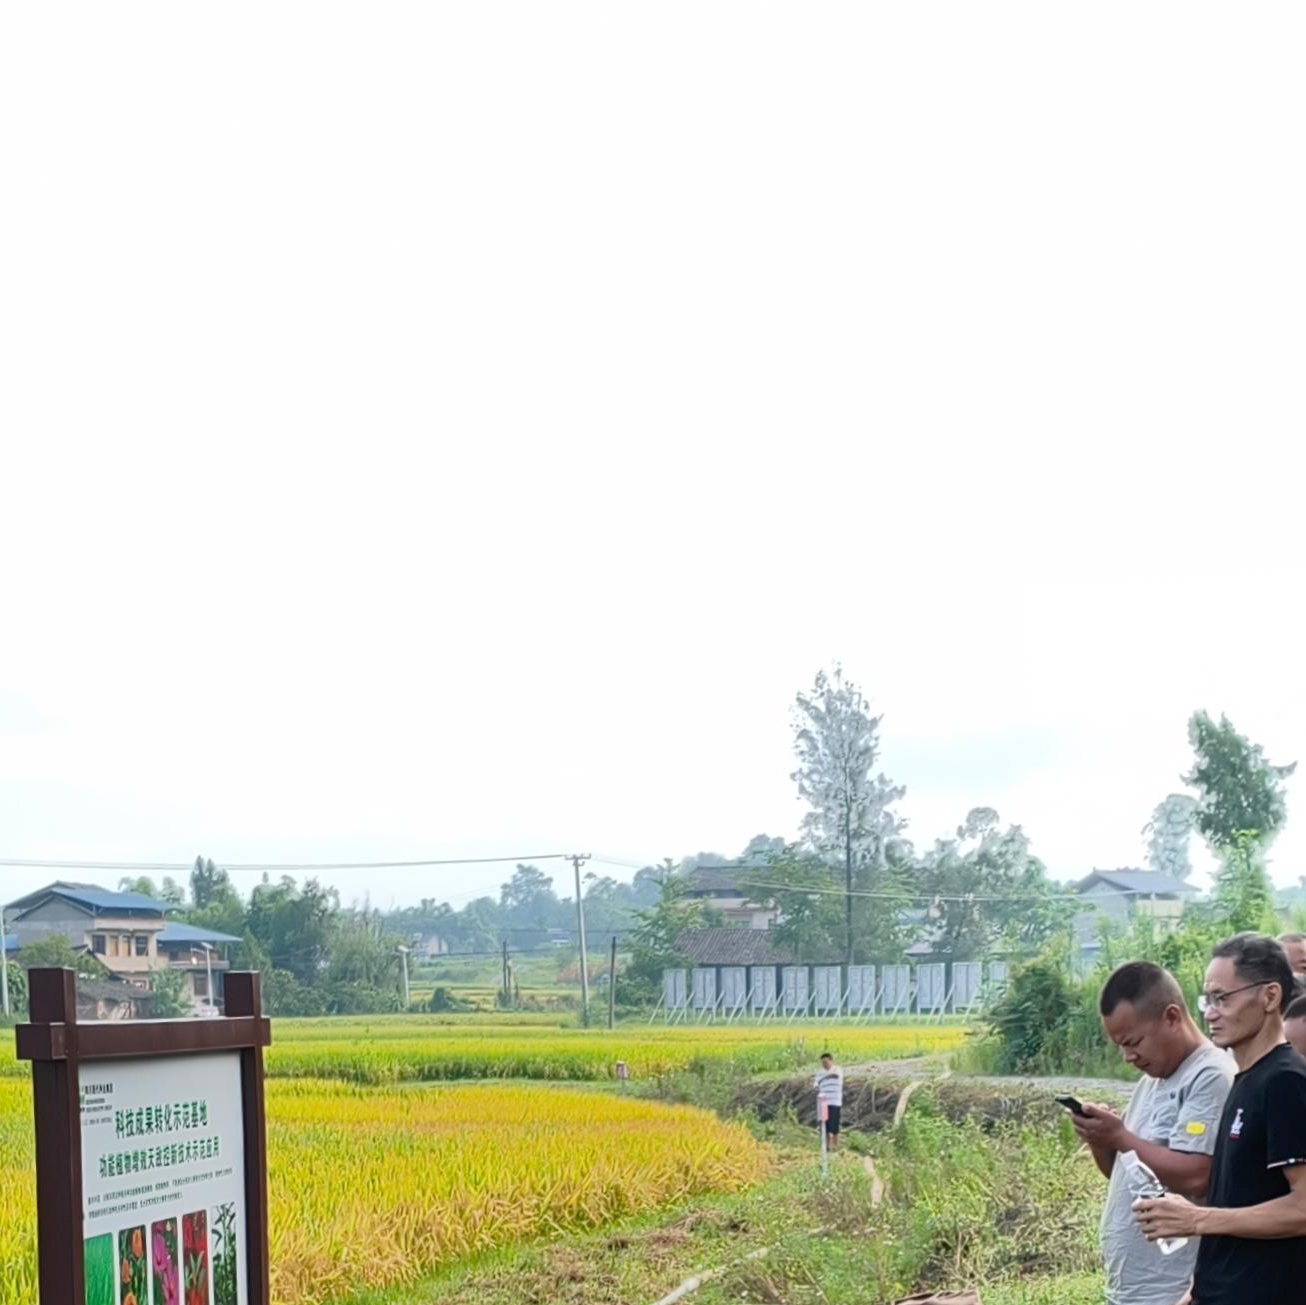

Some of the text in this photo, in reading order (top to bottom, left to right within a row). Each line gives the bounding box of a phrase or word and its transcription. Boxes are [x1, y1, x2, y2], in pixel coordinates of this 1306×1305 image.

[115, 1099, 208, 1139] 科技成果转化示范基地
